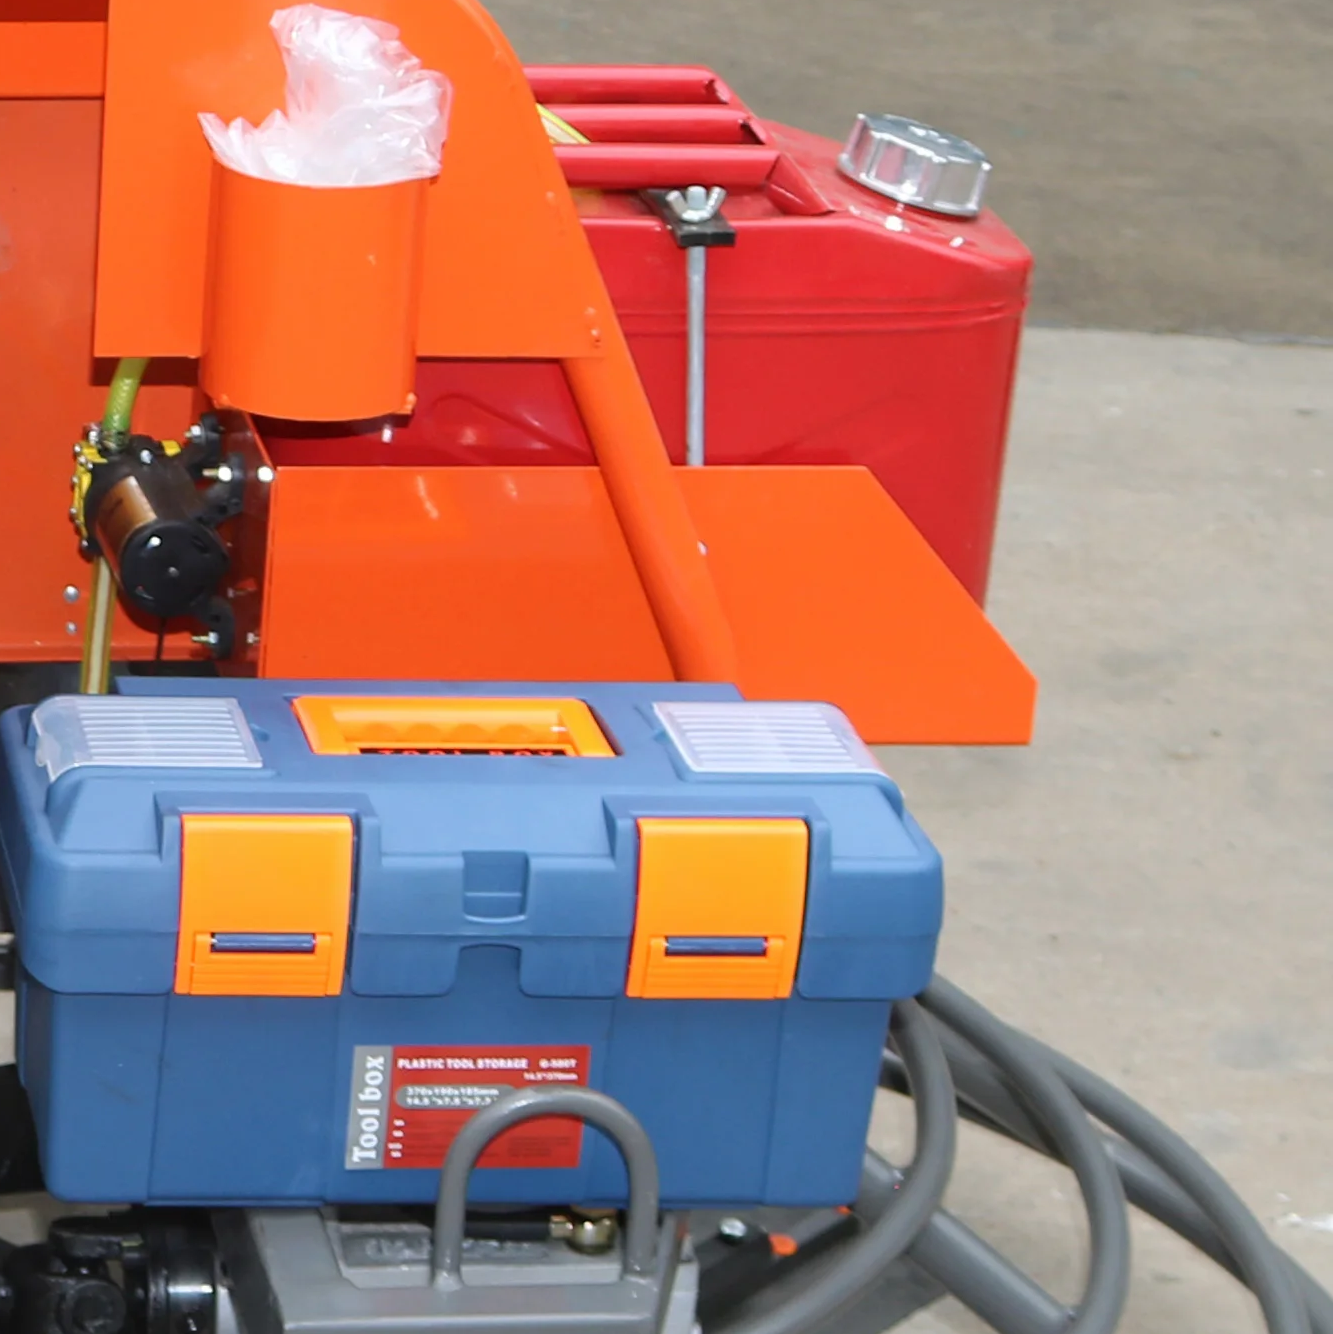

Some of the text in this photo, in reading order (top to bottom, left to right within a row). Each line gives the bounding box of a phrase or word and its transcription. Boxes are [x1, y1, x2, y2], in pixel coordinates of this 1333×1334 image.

[397, 1058, 444, 1069] PLASTIC
[447, 1058, 475, 1069] TOOL
[477, 1058, 529, 1069] STORAGE
[352, 1055, 385, 1162] Tool box
